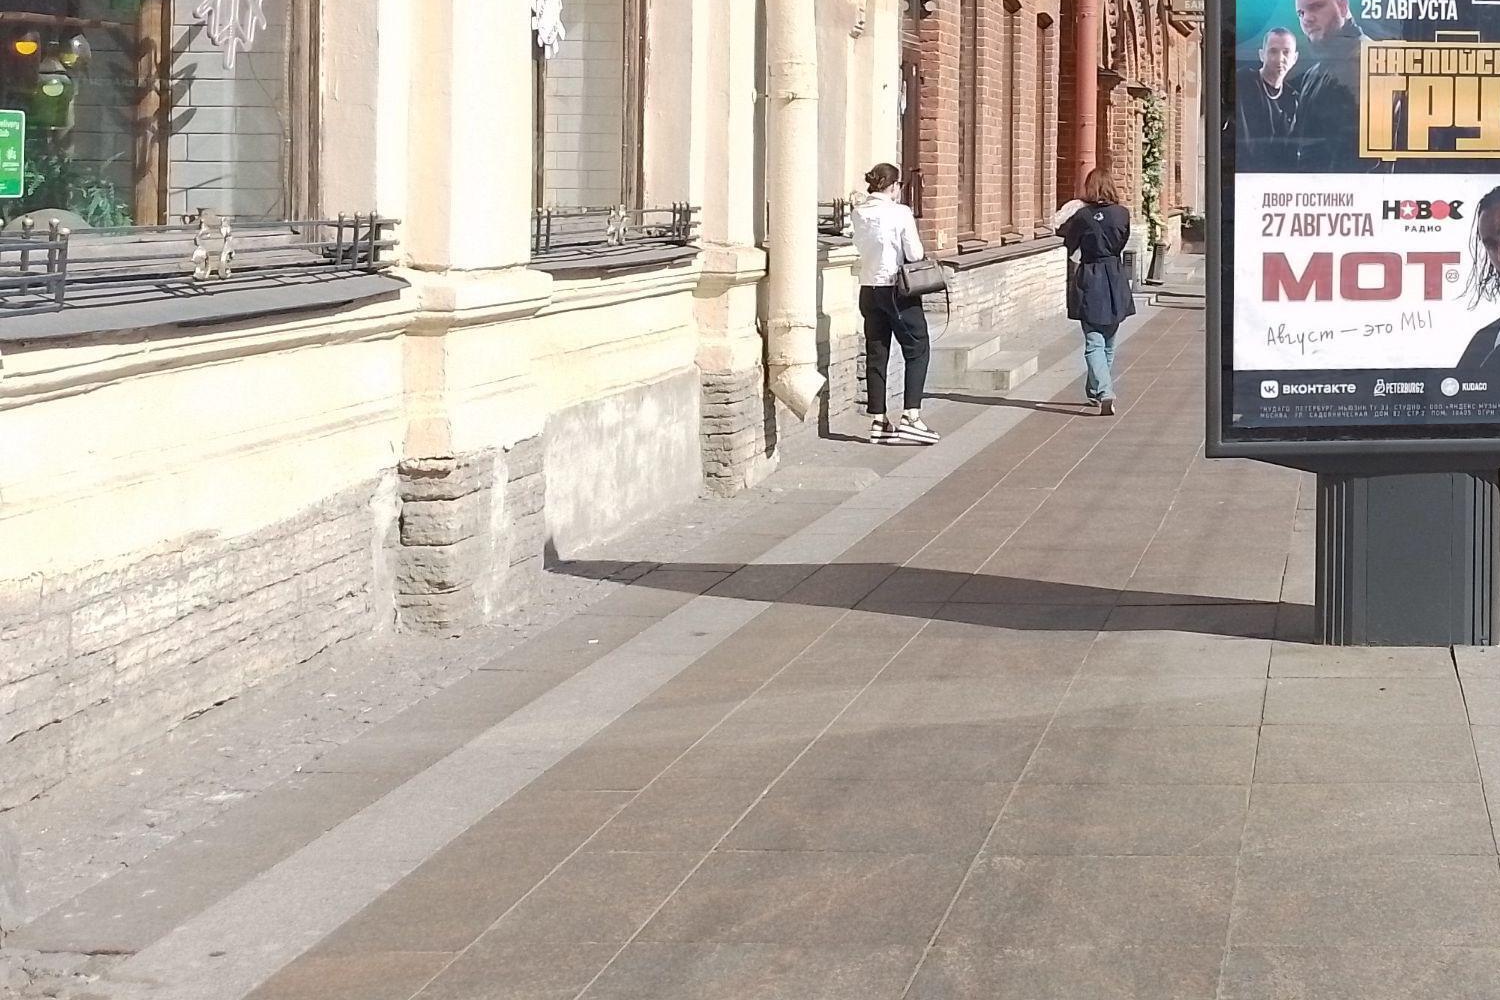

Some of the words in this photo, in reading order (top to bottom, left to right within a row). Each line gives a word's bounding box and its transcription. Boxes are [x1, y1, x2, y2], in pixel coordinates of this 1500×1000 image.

[1361, 0, 1382, 19] 25
[1386, 0, 1458, 20] АВГУСТА
[1261, 193, 1293, 208] ДВОР
[1295, 193, 1354, 207] ГОСТИНКИ
[1261, 213, 1286, 237] 27
[1290, 213, 1375, 237] АВГУСТА
[1404, 225, 1442, 233] РАДИО
[1262, 252, 1461, 302] МОТ
[1266, 323, 1334, 355] Август
[1363, 323, 1393, 337] это
[1400, 310, 1433, 331] МЫ
